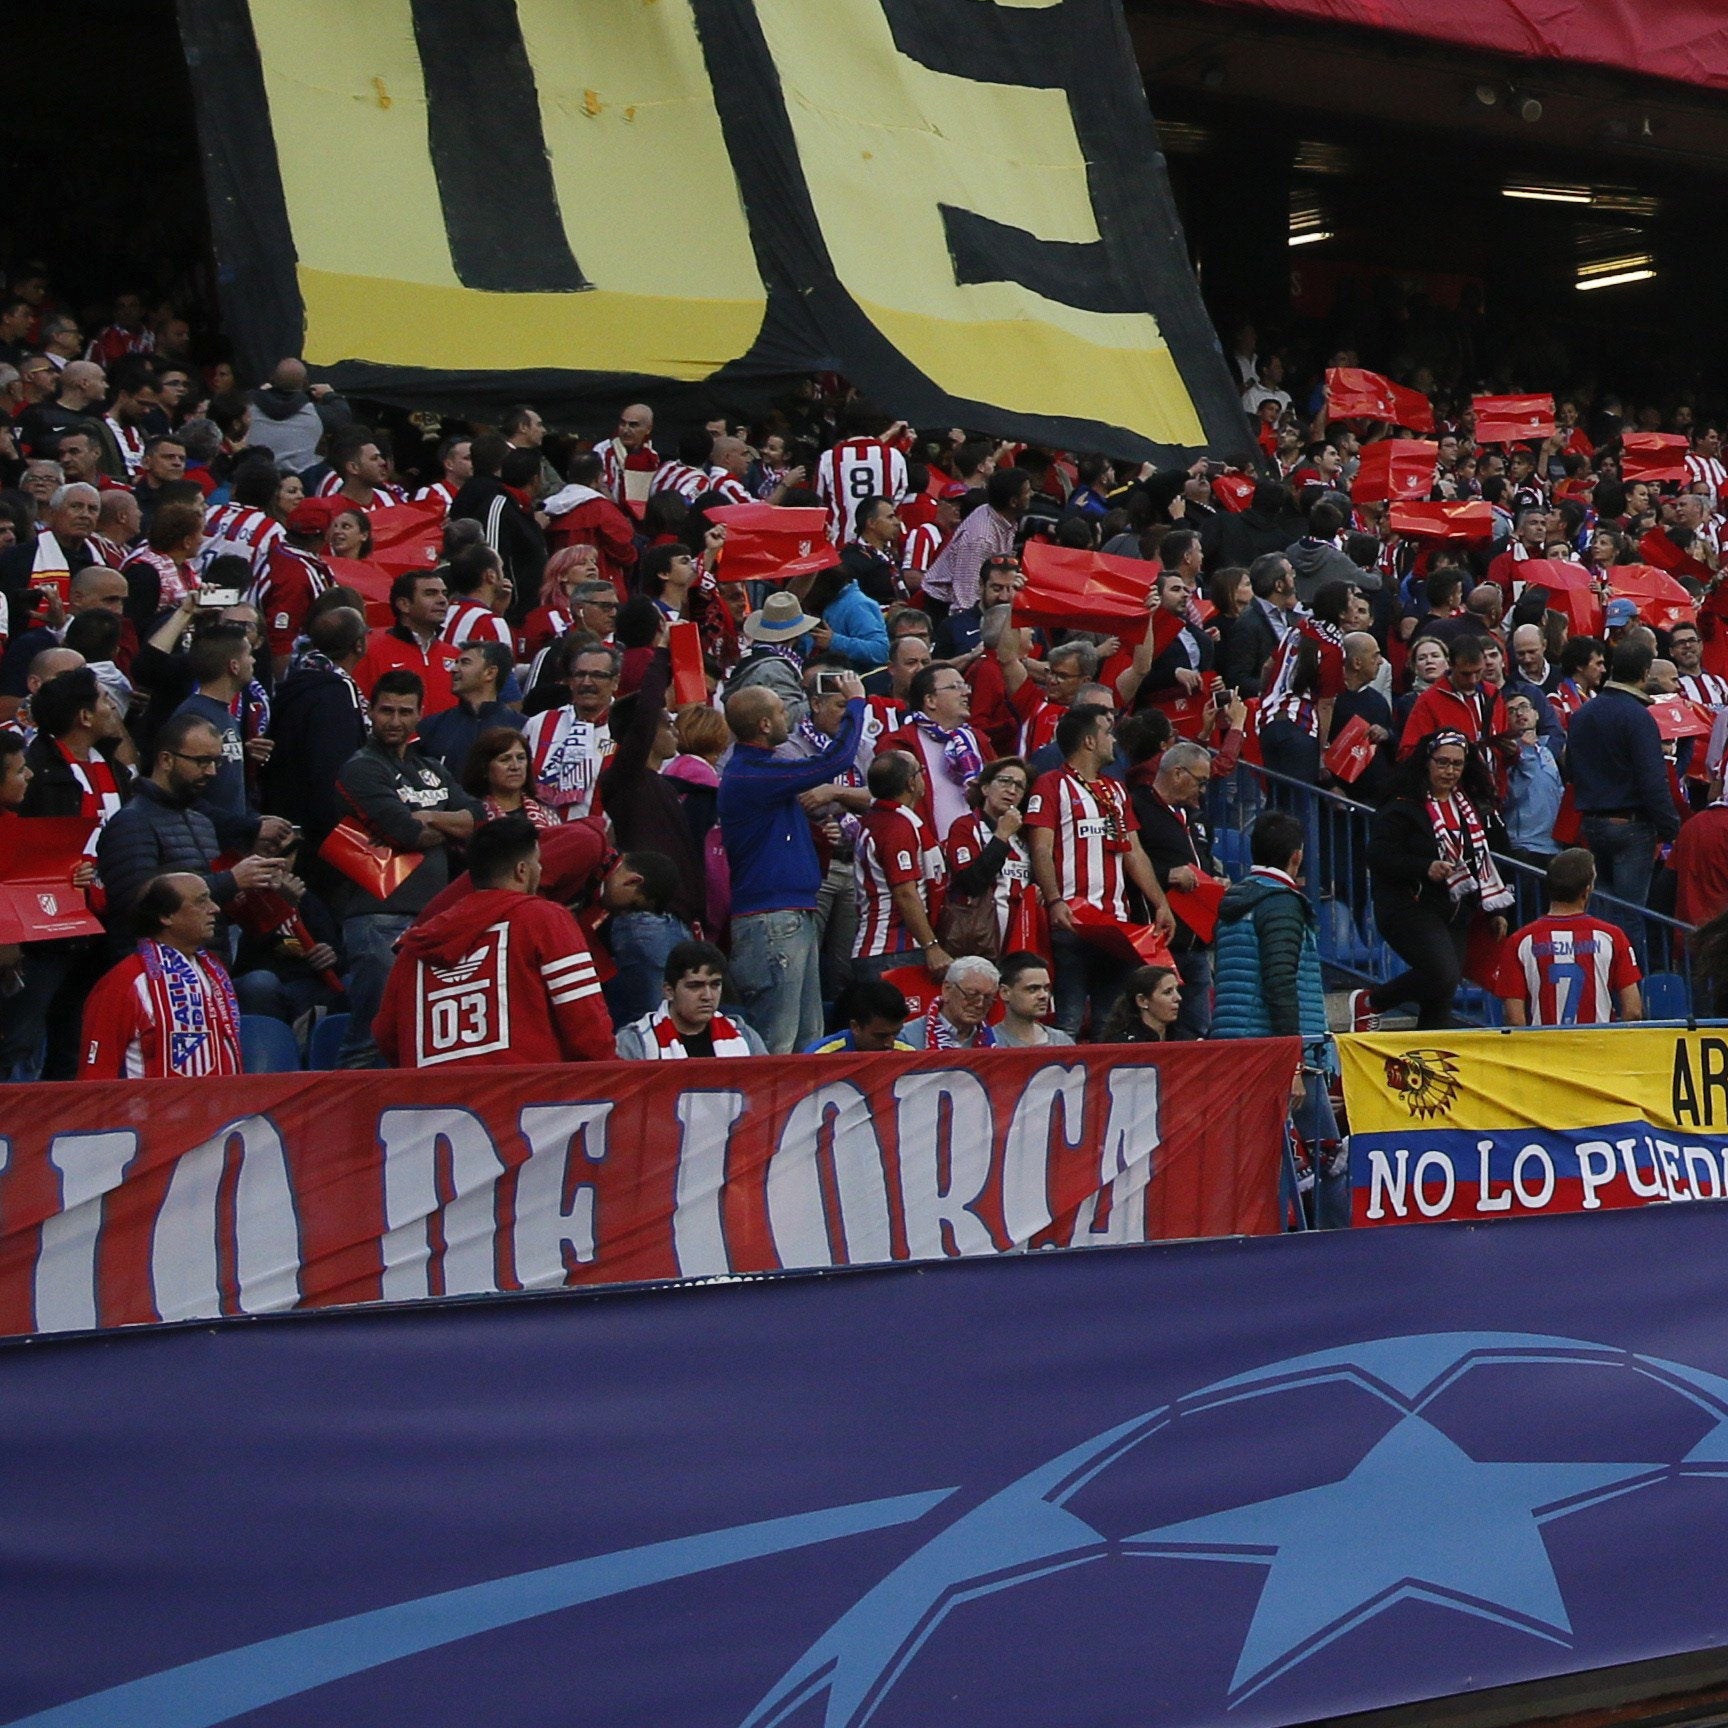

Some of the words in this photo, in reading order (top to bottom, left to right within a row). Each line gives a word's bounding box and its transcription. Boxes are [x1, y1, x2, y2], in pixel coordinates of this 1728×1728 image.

[849, 466, 875, 498] 8
[431, 998, 488, 1051] 03
[1547, 962, 1587, 1025] 7
[377, 1104, 616, 1301] DE
[1365, 1147, 1456, 1221] NO
[1475, 1140, 1556, 1212] LO
